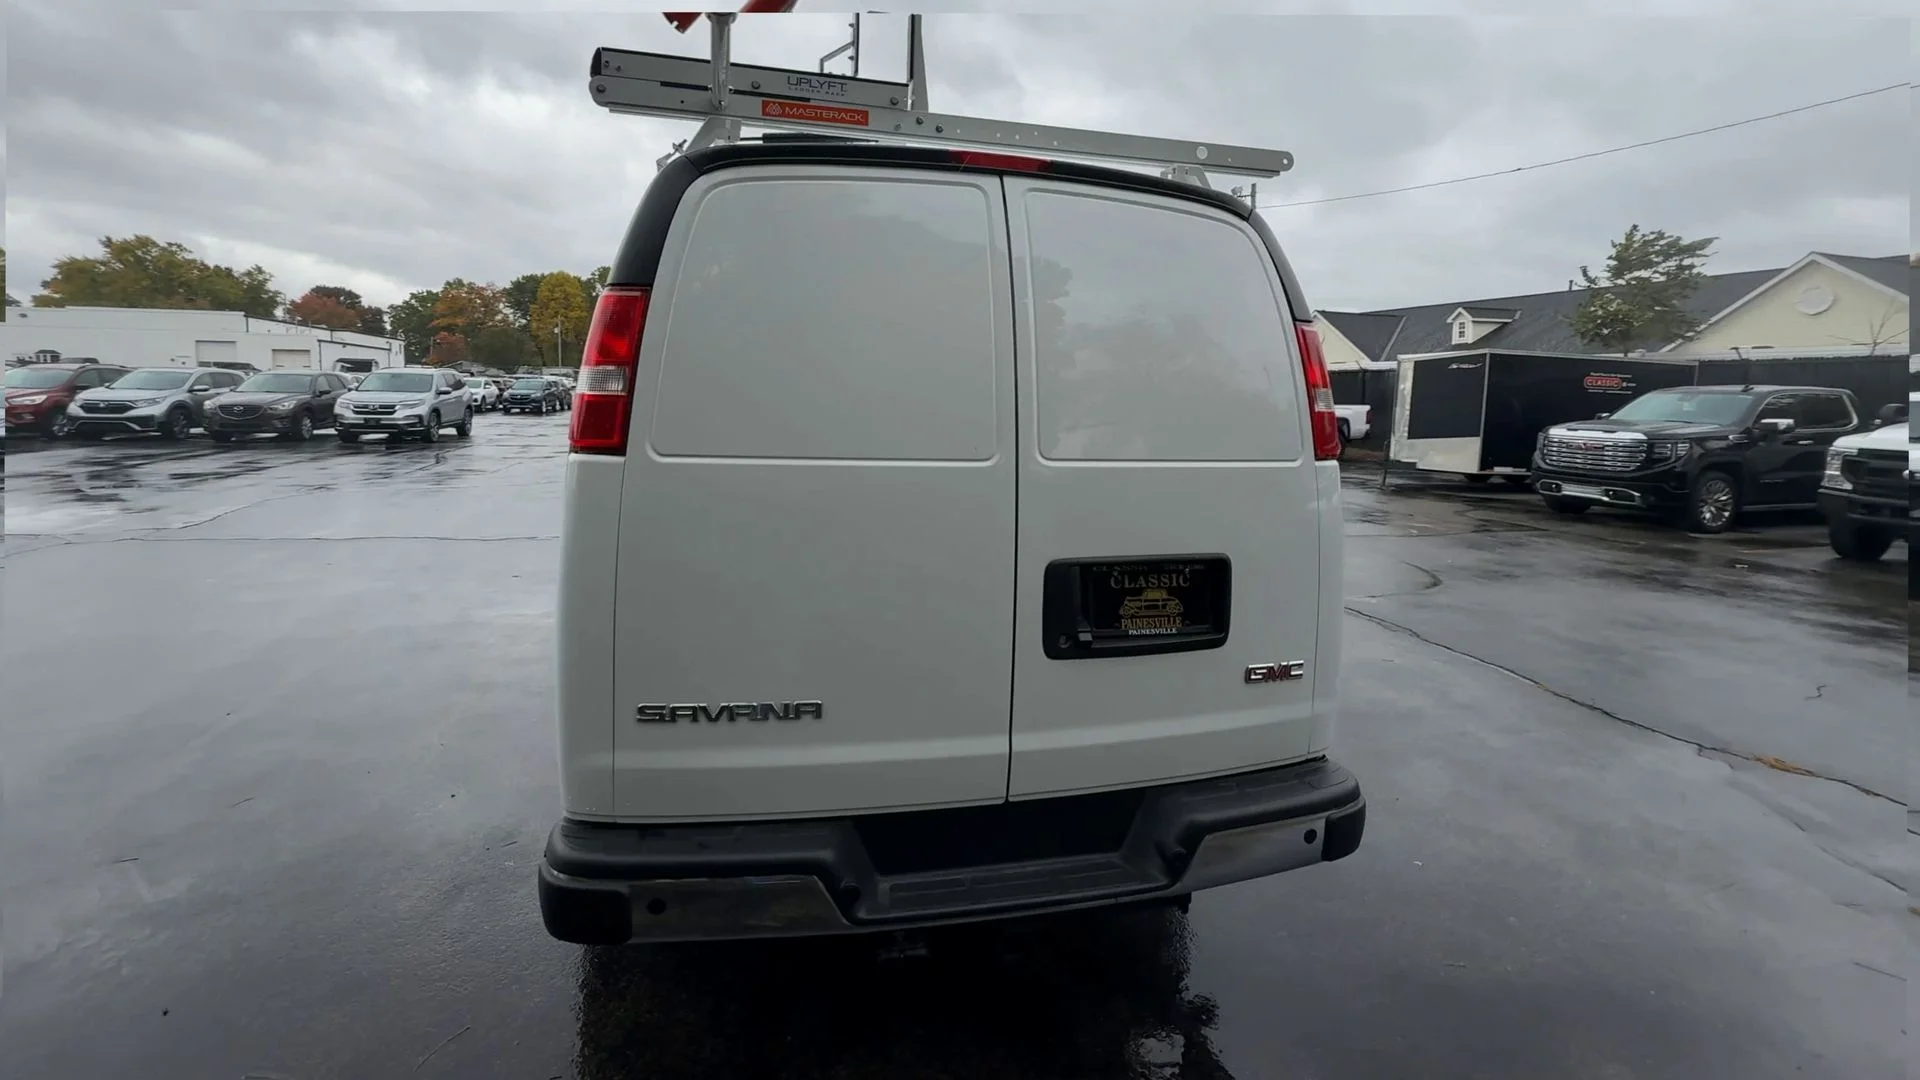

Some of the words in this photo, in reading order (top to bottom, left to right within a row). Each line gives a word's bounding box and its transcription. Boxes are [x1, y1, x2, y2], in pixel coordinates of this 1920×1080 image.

[787, 76, 848, 92] UPLYFT
[785, 106, 864, 121] MASTERACK
[1586, 379, 1620, 388] CLASSIC
[1110, 573, 1191, 589] CLASSIC
[1121, 616, 1183, 630] PAINESVILLE
[1128, 627, 1178, 636] PAINESVILLE
[1244, 660, 1304, 684] GMC
[636, 700, 822, 722] SAVANA
